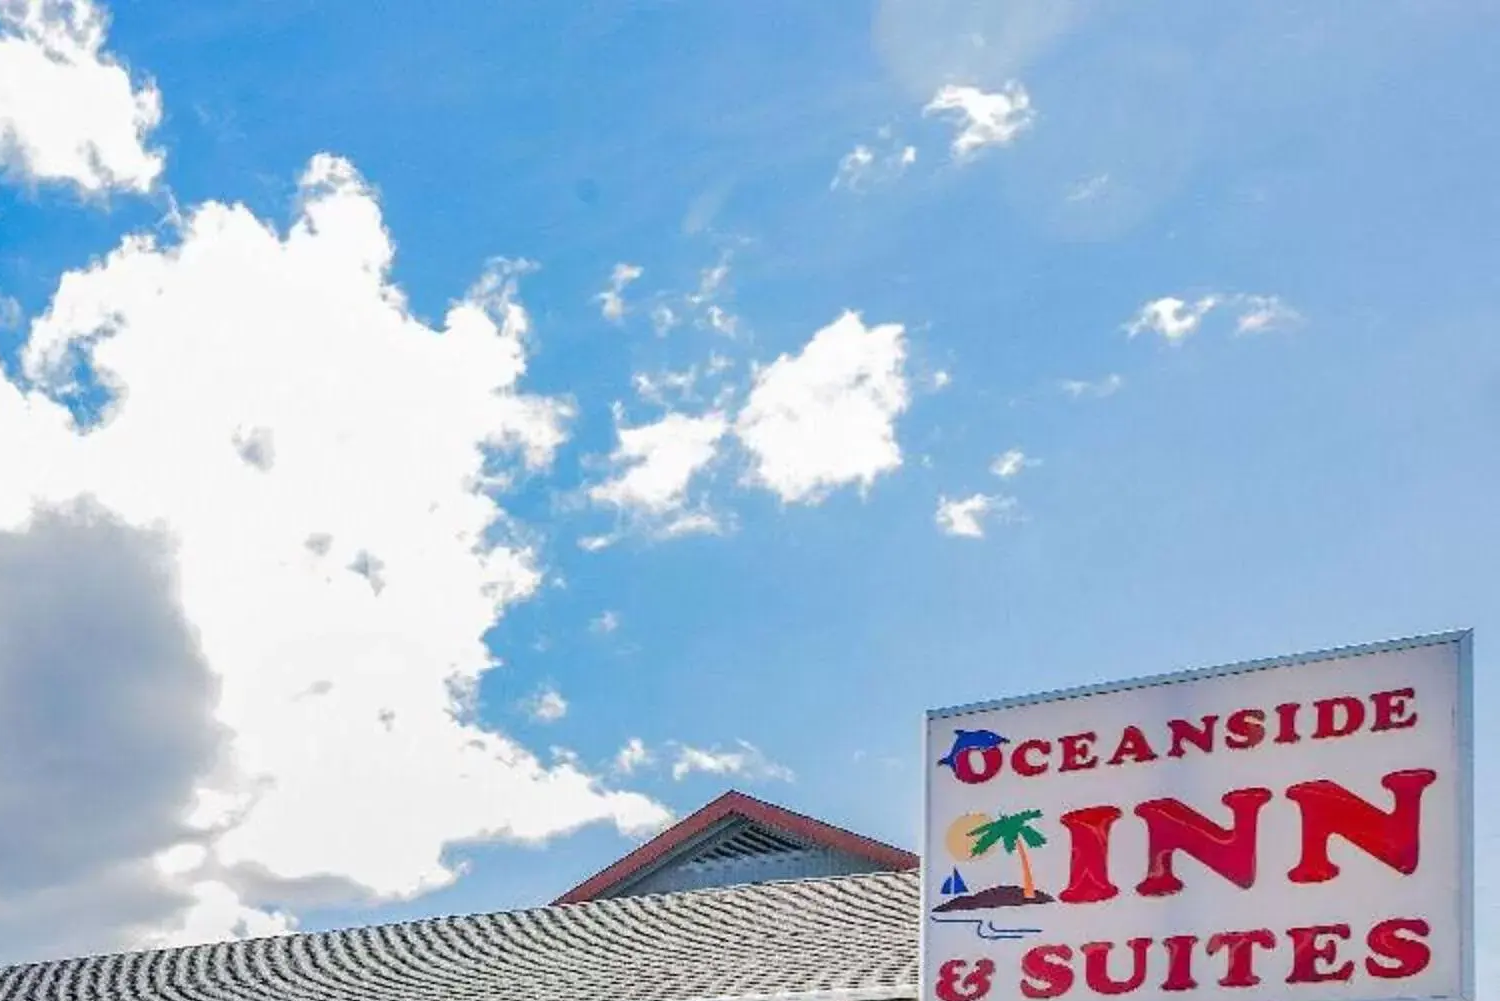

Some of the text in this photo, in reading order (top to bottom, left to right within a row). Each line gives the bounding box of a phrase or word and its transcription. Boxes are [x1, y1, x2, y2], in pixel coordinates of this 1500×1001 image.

[953, 687, 1419, 785] OCEANSIDE
[1057, 767, 1438, 905] INN
[1020, 917, 1433, 1000] SUITES
